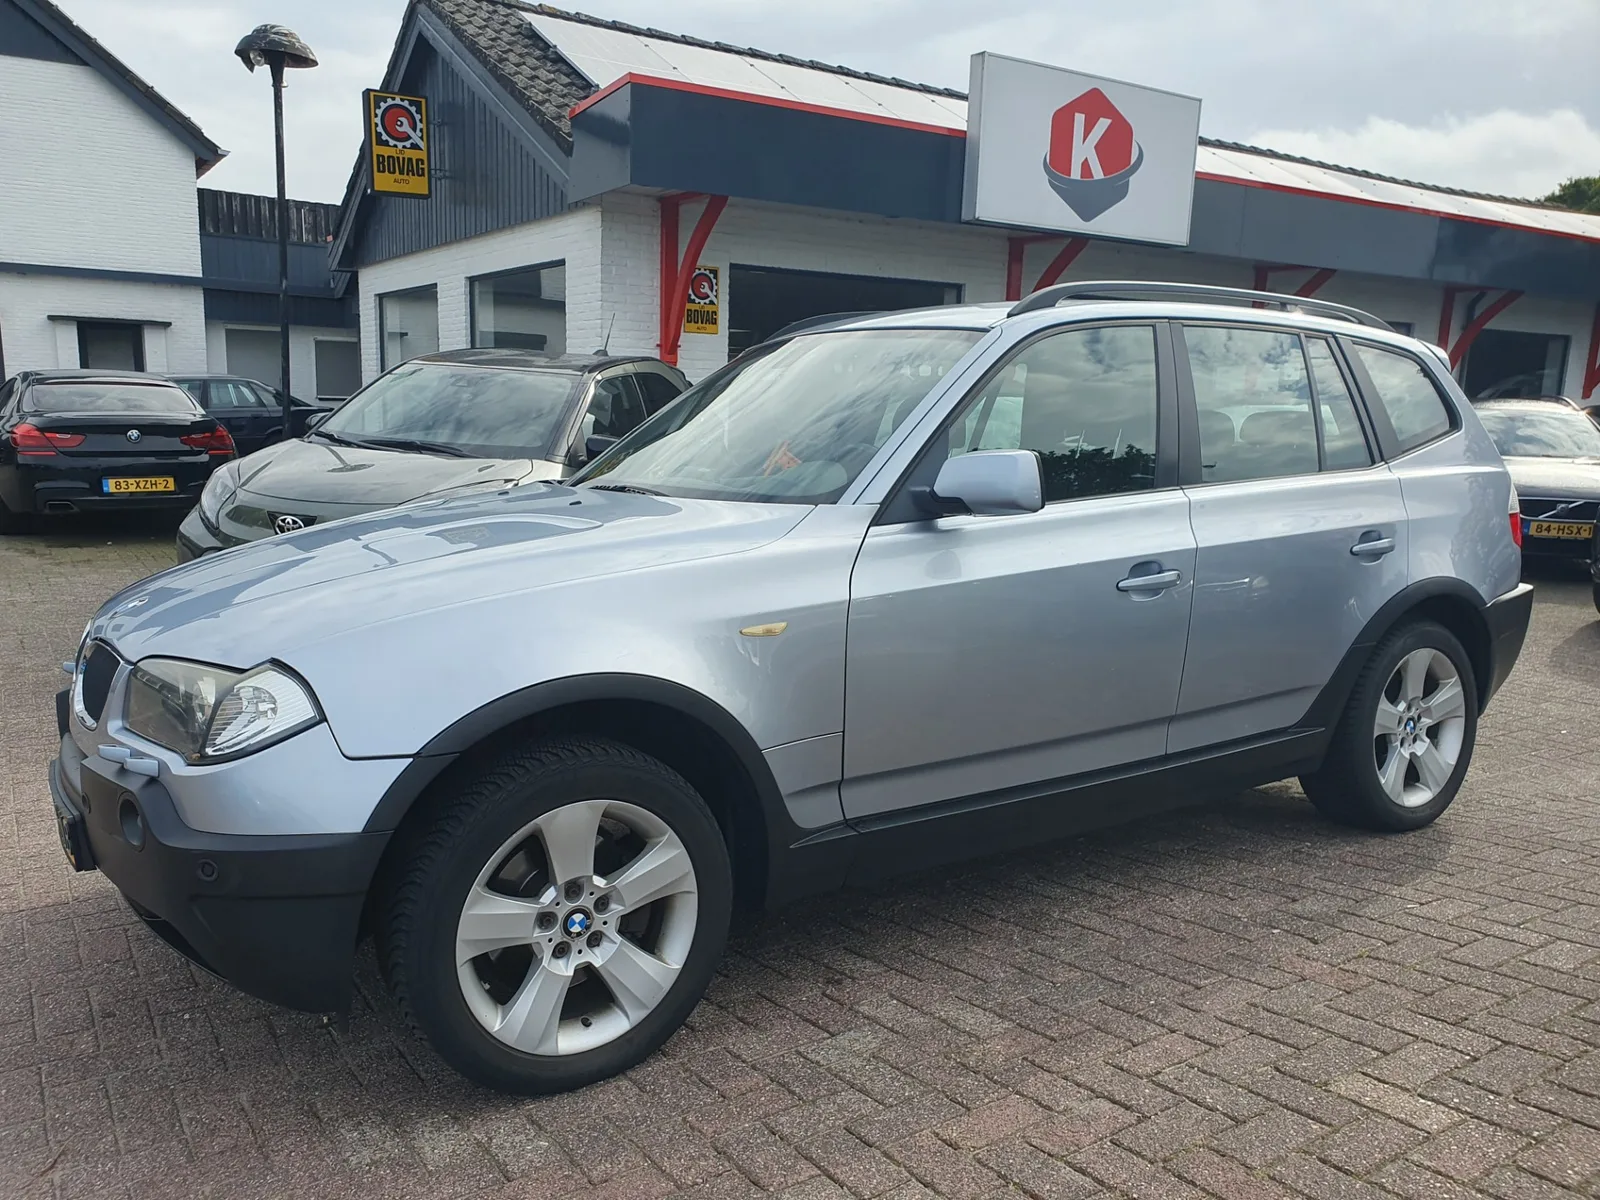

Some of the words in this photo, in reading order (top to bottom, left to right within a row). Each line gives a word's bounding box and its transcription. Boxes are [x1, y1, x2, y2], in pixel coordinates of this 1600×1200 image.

[1070, 112, 1113, 179] K
[376, 154, 425, 177] BOVAG
[686, 309, 717, 325] BOVAG
[114, 479, 170, 491] 83-XZH-2
[1535, 523, 1592, 536] 84-HSX-1
